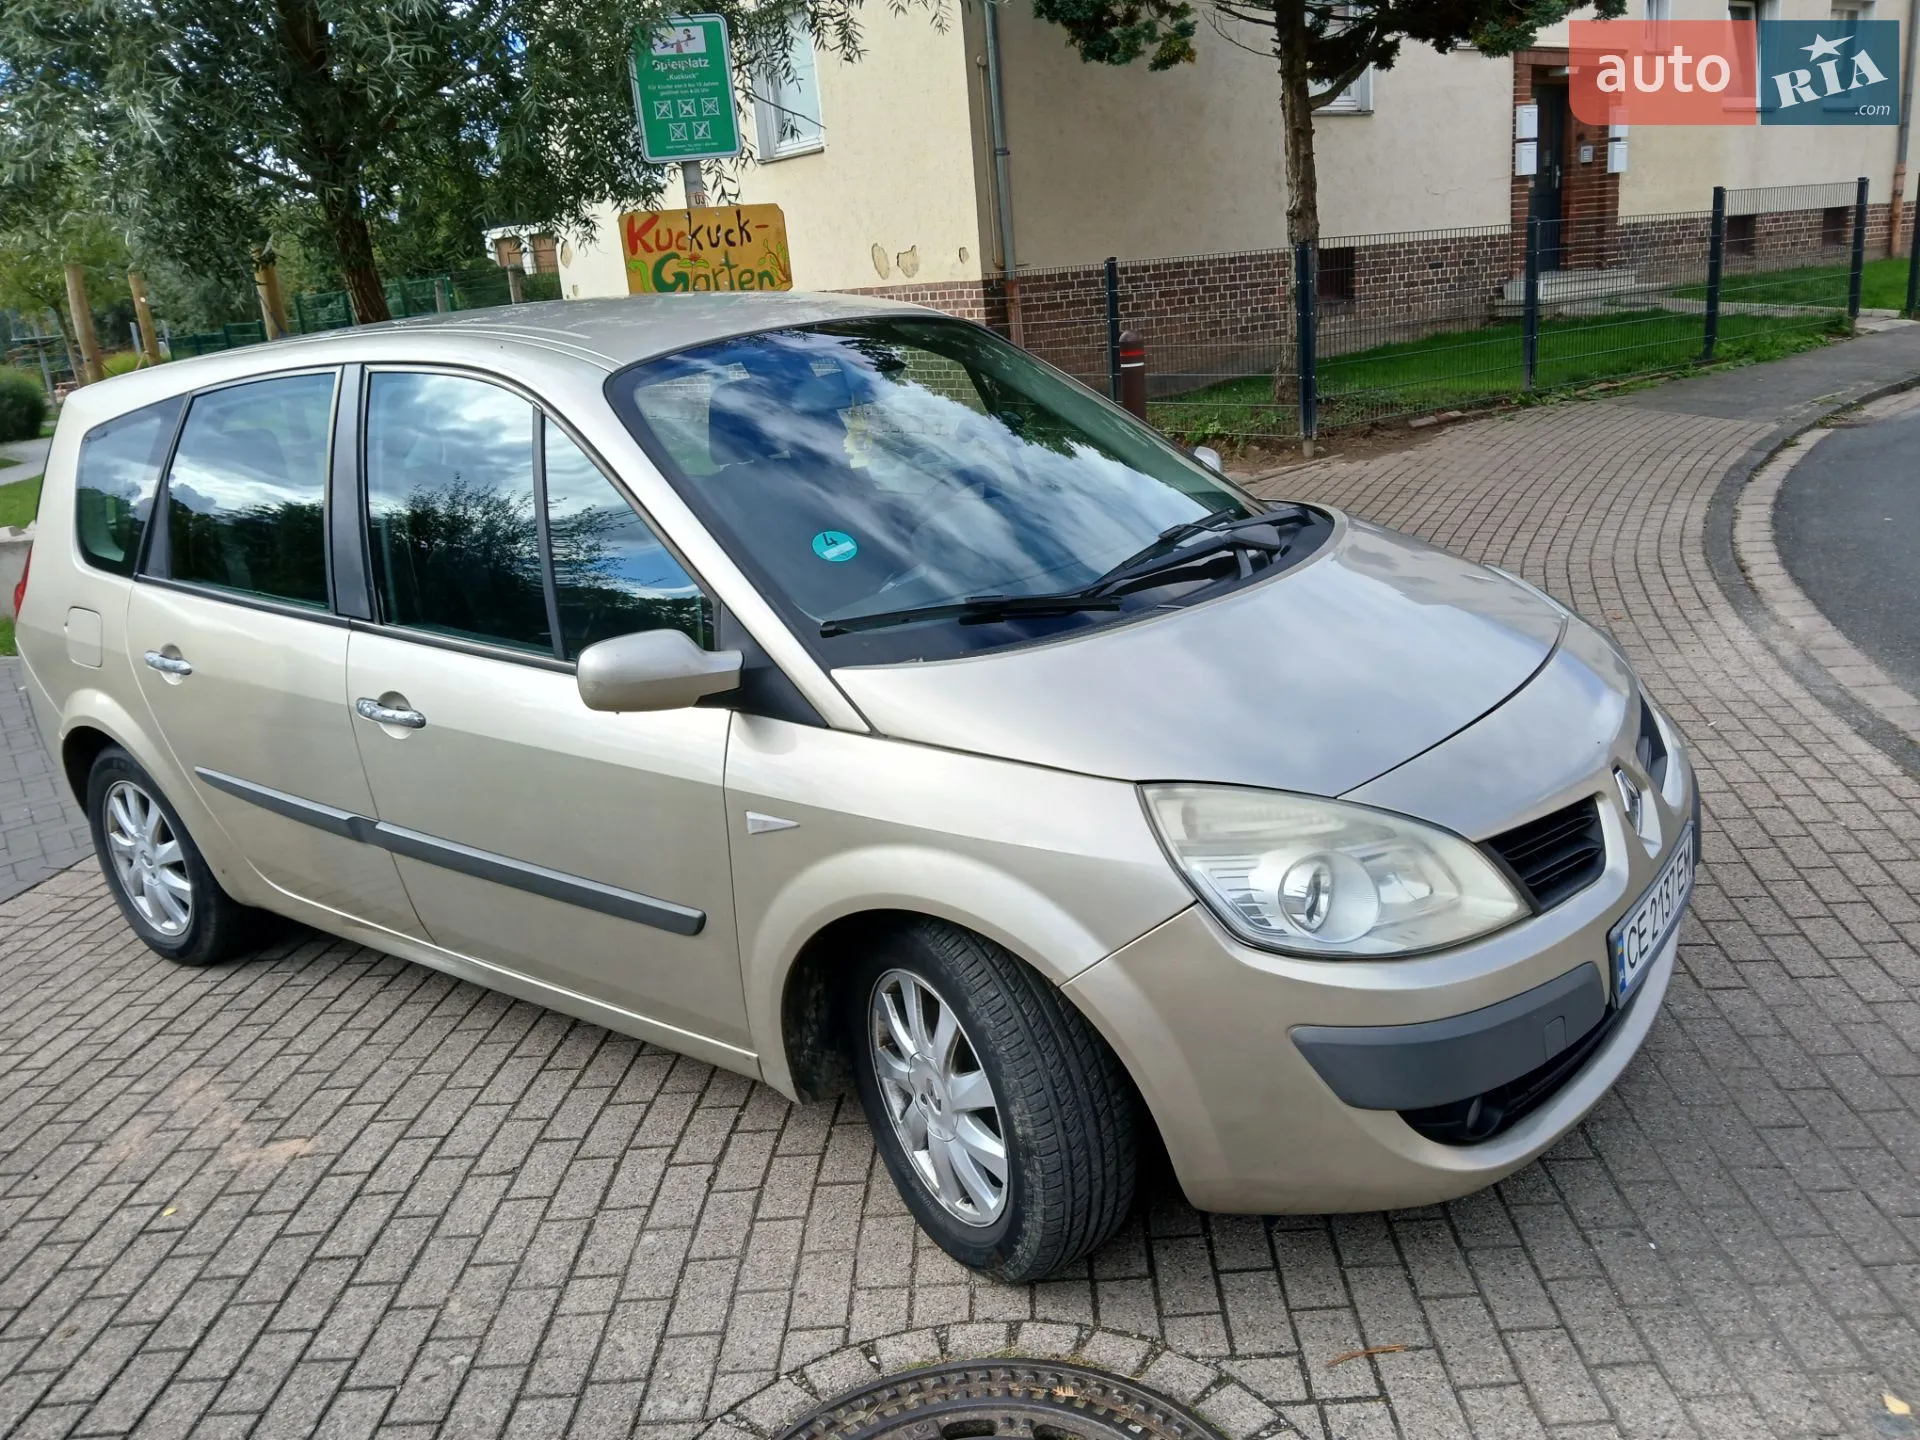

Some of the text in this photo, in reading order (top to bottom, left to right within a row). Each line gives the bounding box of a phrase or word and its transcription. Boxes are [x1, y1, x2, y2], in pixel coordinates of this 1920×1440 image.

[652, 57, 710, 72] Spielplatz
[626, 209, 769, 256] Kuckuck-
[652, 250, 776, 293] Garten
[822, 532, 839, 547] 4
[1627, 910, 1649, 969] CE
[1650, 865, 1676, 942] 2137
